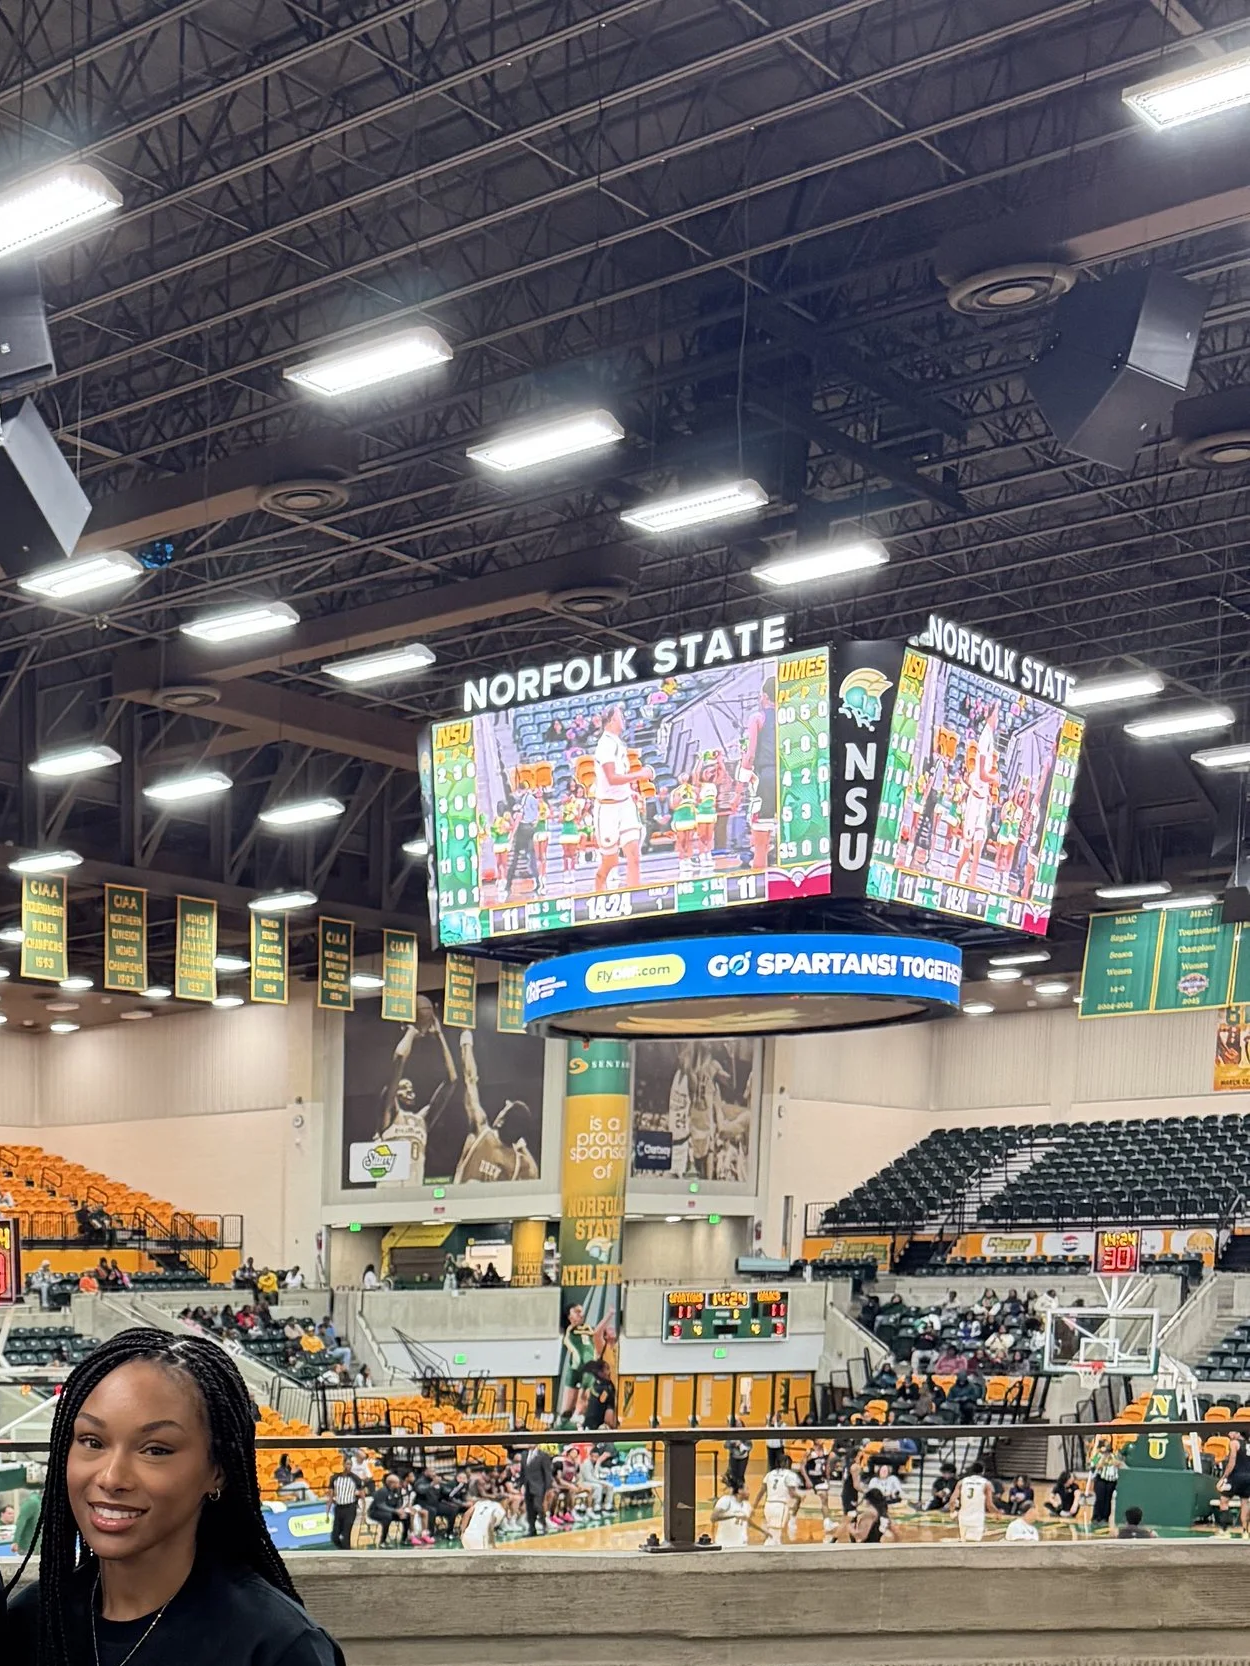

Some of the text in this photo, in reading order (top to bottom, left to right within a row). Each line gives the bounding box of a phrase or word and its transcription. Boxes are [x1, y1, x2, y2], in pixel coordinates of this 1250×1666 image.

[463, 616, 786, 712] NORFOLK STATE
[904, 653, 927, 681] NSU
[928, 614, 1075, 701] NORFOLK STATE
[779, 655, 827, 683] UMES
[436, 723, 472, 748] NSU
[801, 767, 811, 784] 2
[801, 802, 812, 820] 3
[839, 742, 877, 871] NSU
[30, 880, 60, 899] CIAA
[113, 895, 138, 910] CIAA
[502, 908, 519, 932] 11
[737, 875, 756, 899] 11
[707, 951, 897, 977] GO SPARTANS!
[1106, 967, 1133, 977] Women
[1181, 962, 1209, 971] Women
[589, 1115, 621, 1131] is a
[593, 1162, 613, 1179] of
[1103, 1229, 1137, 1247] 14:24
[1103, 1246, 1132, 1271] 30
[712, 1291, 748, 1306] 14:24
